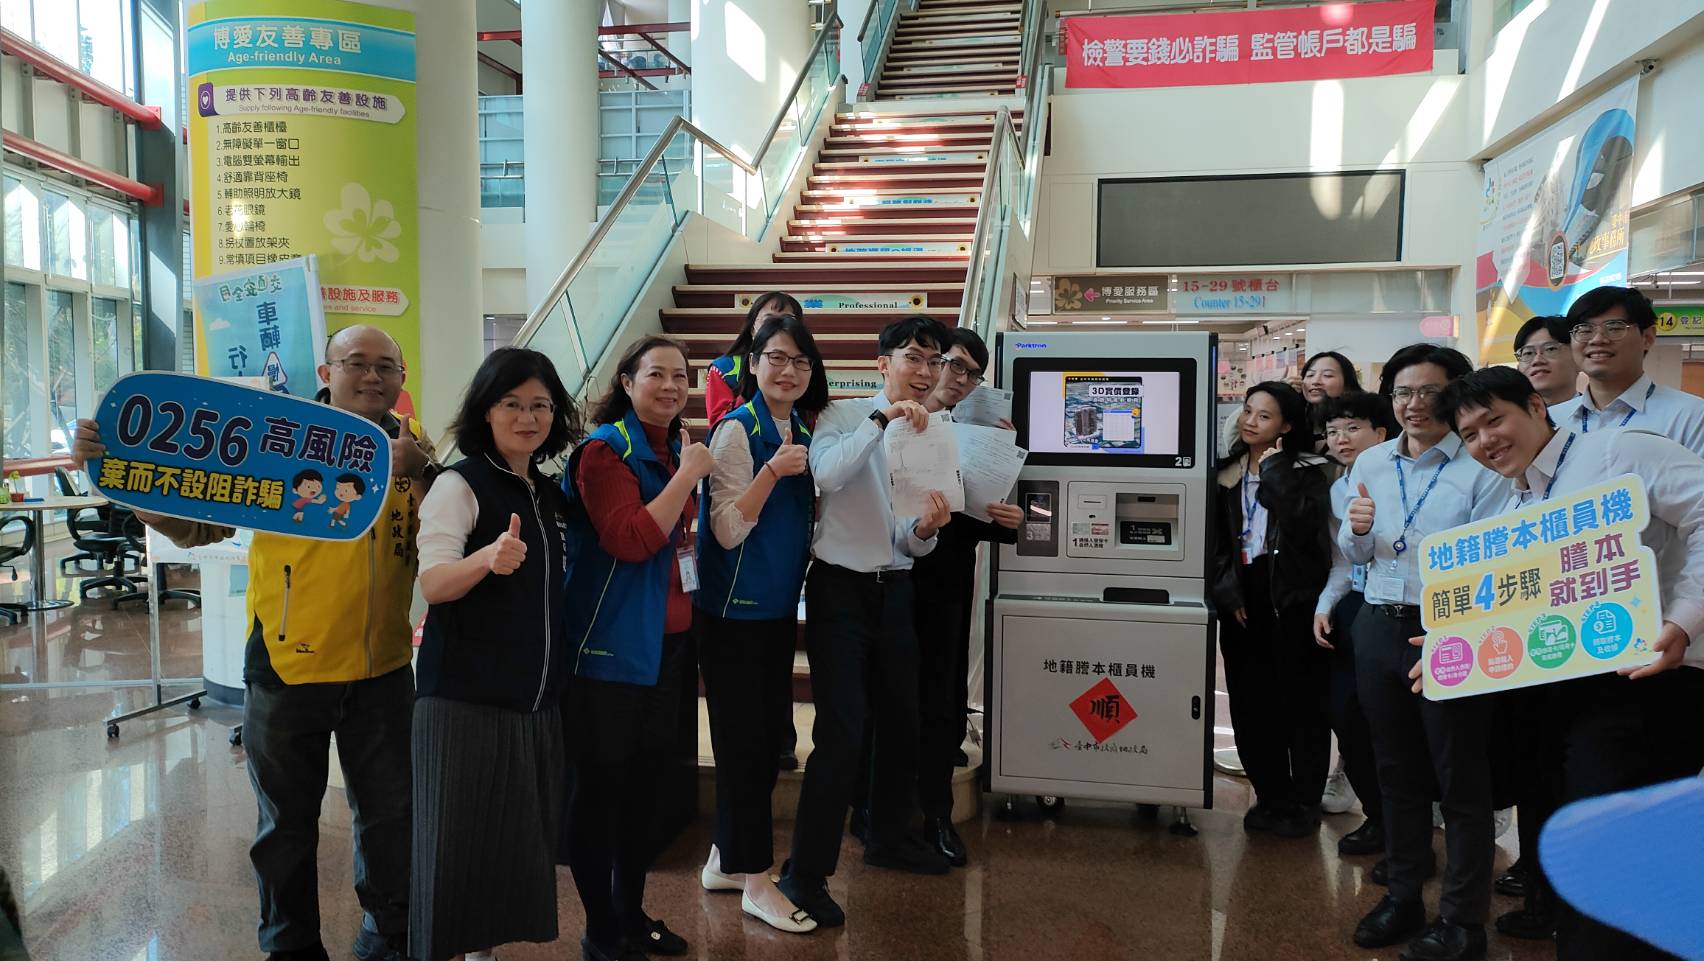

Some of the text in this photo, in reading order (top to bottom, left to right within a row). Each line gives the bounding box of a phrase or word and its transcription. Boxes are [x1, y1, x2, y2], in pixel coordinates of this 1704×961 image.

[213, 25, 362, 54] 博愛友善專區
[1082, 23, 1417, 67] 檢警要錢必詐騙 監管帳戶都是騙
[228, 51, 342, 65] Age-friendly Area
[225, 87, 387, 110] 提供下列高齡友善設施
[238, 104, 370, 118] Supply following Age-friendly facilities
[1101, 285, 1159, 297] 博愛服務區
[1183, 278, 1280, 293] 15-29 號櫃台
[839, 301, 898, 309] Professional
[1193, 295, 1231, 310] Counter
[1660, 316, 1674, 327] 14
[828, 379, 877, 389] erprising
[116, 394, 378, 474] 0256 高風險
[1174, 457, 1183, 467] 2
[98, 456, 286, 512] 棄而不設阻詐騙
[1428, 487, 1634, 572] 地籍謄本櫃員機
[1559, 532, 1626, 574] 謄本
[1548, 559, 1642, 607] 就到手
[1431, 567, 1542, 622] 簡單4步驟
[1043, 659, 1156, 679] 地籍謄本櫃員機
[1090, 694, 1121, 724] 順
